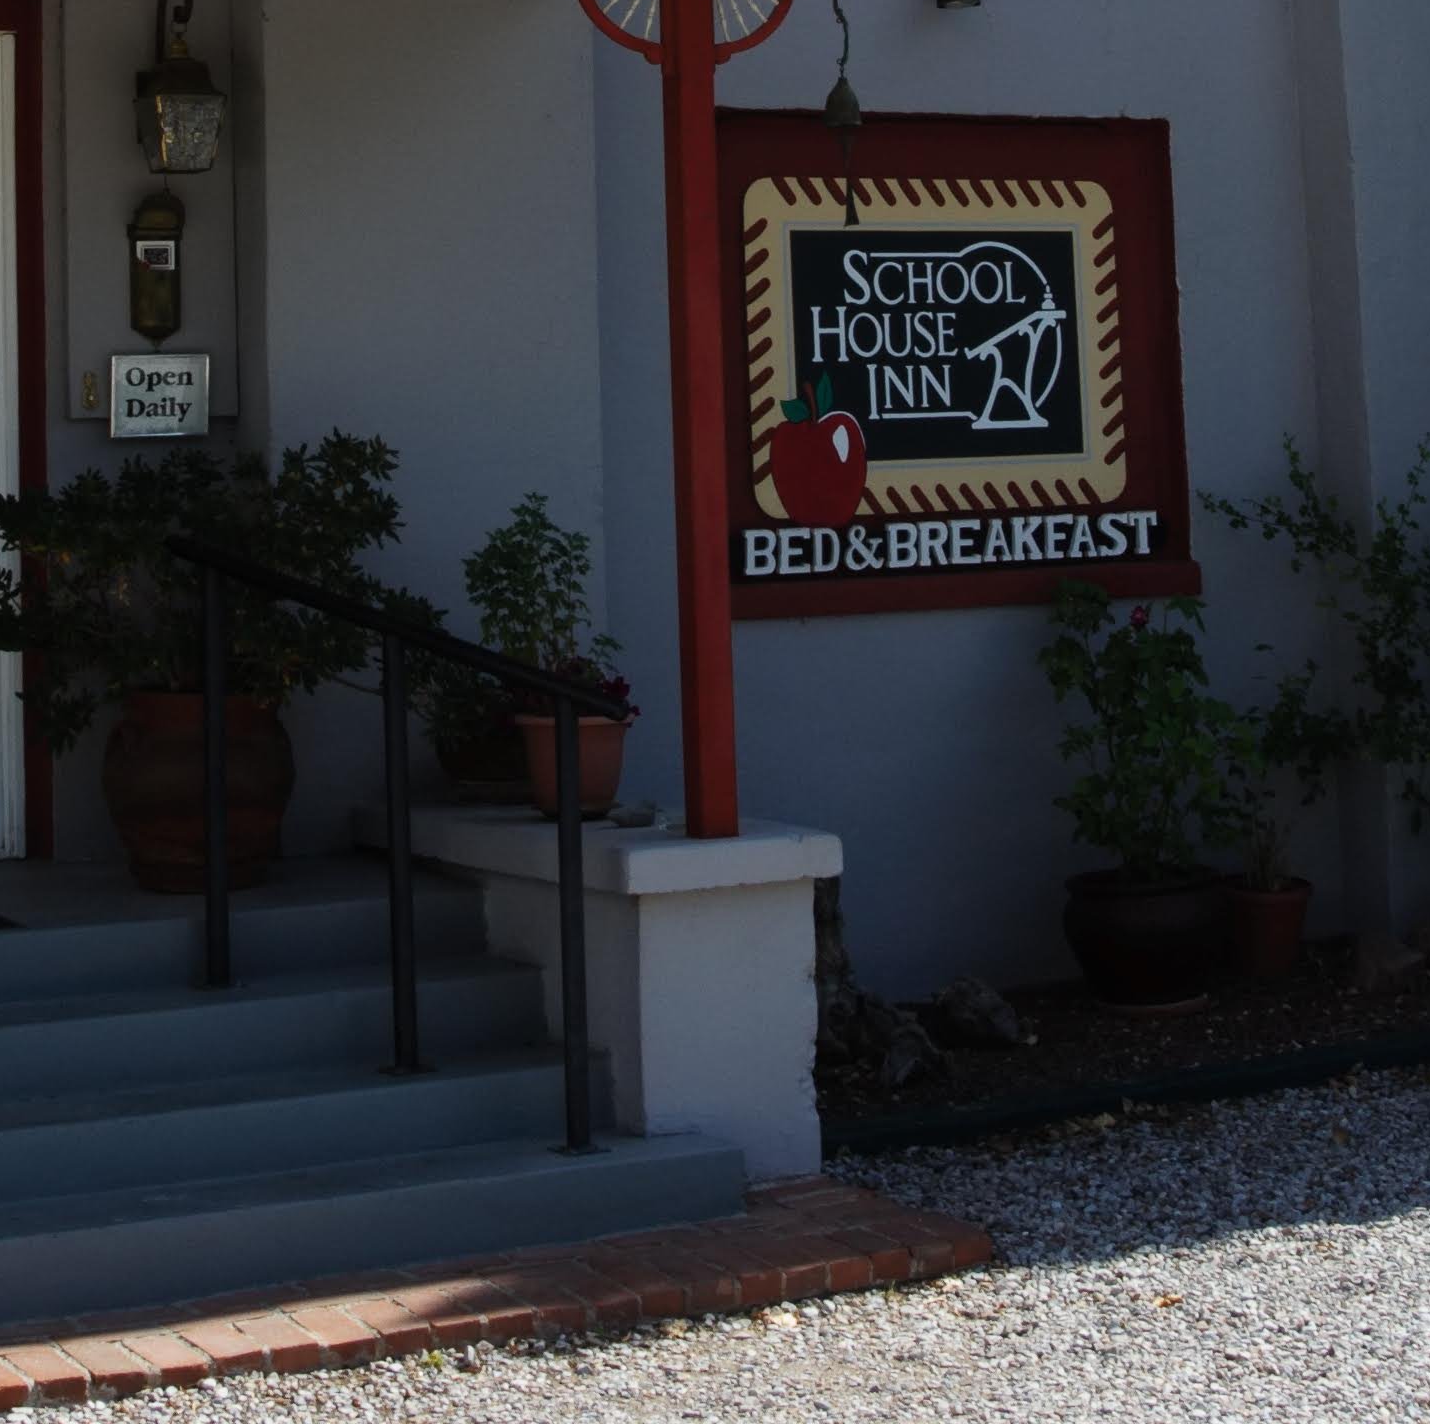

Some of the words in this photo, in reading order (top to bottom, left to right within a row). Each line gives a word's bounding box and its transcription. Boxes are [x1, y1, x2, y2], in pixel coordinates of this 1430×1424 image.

[842, 249, 1027, 306] SCHOOL
[810, 305, 958, 364] HOUSE
[125, 367, 194, 392] Open
[867, 364, 952, 420] INN
[125, 397, 193, 423] Daily
